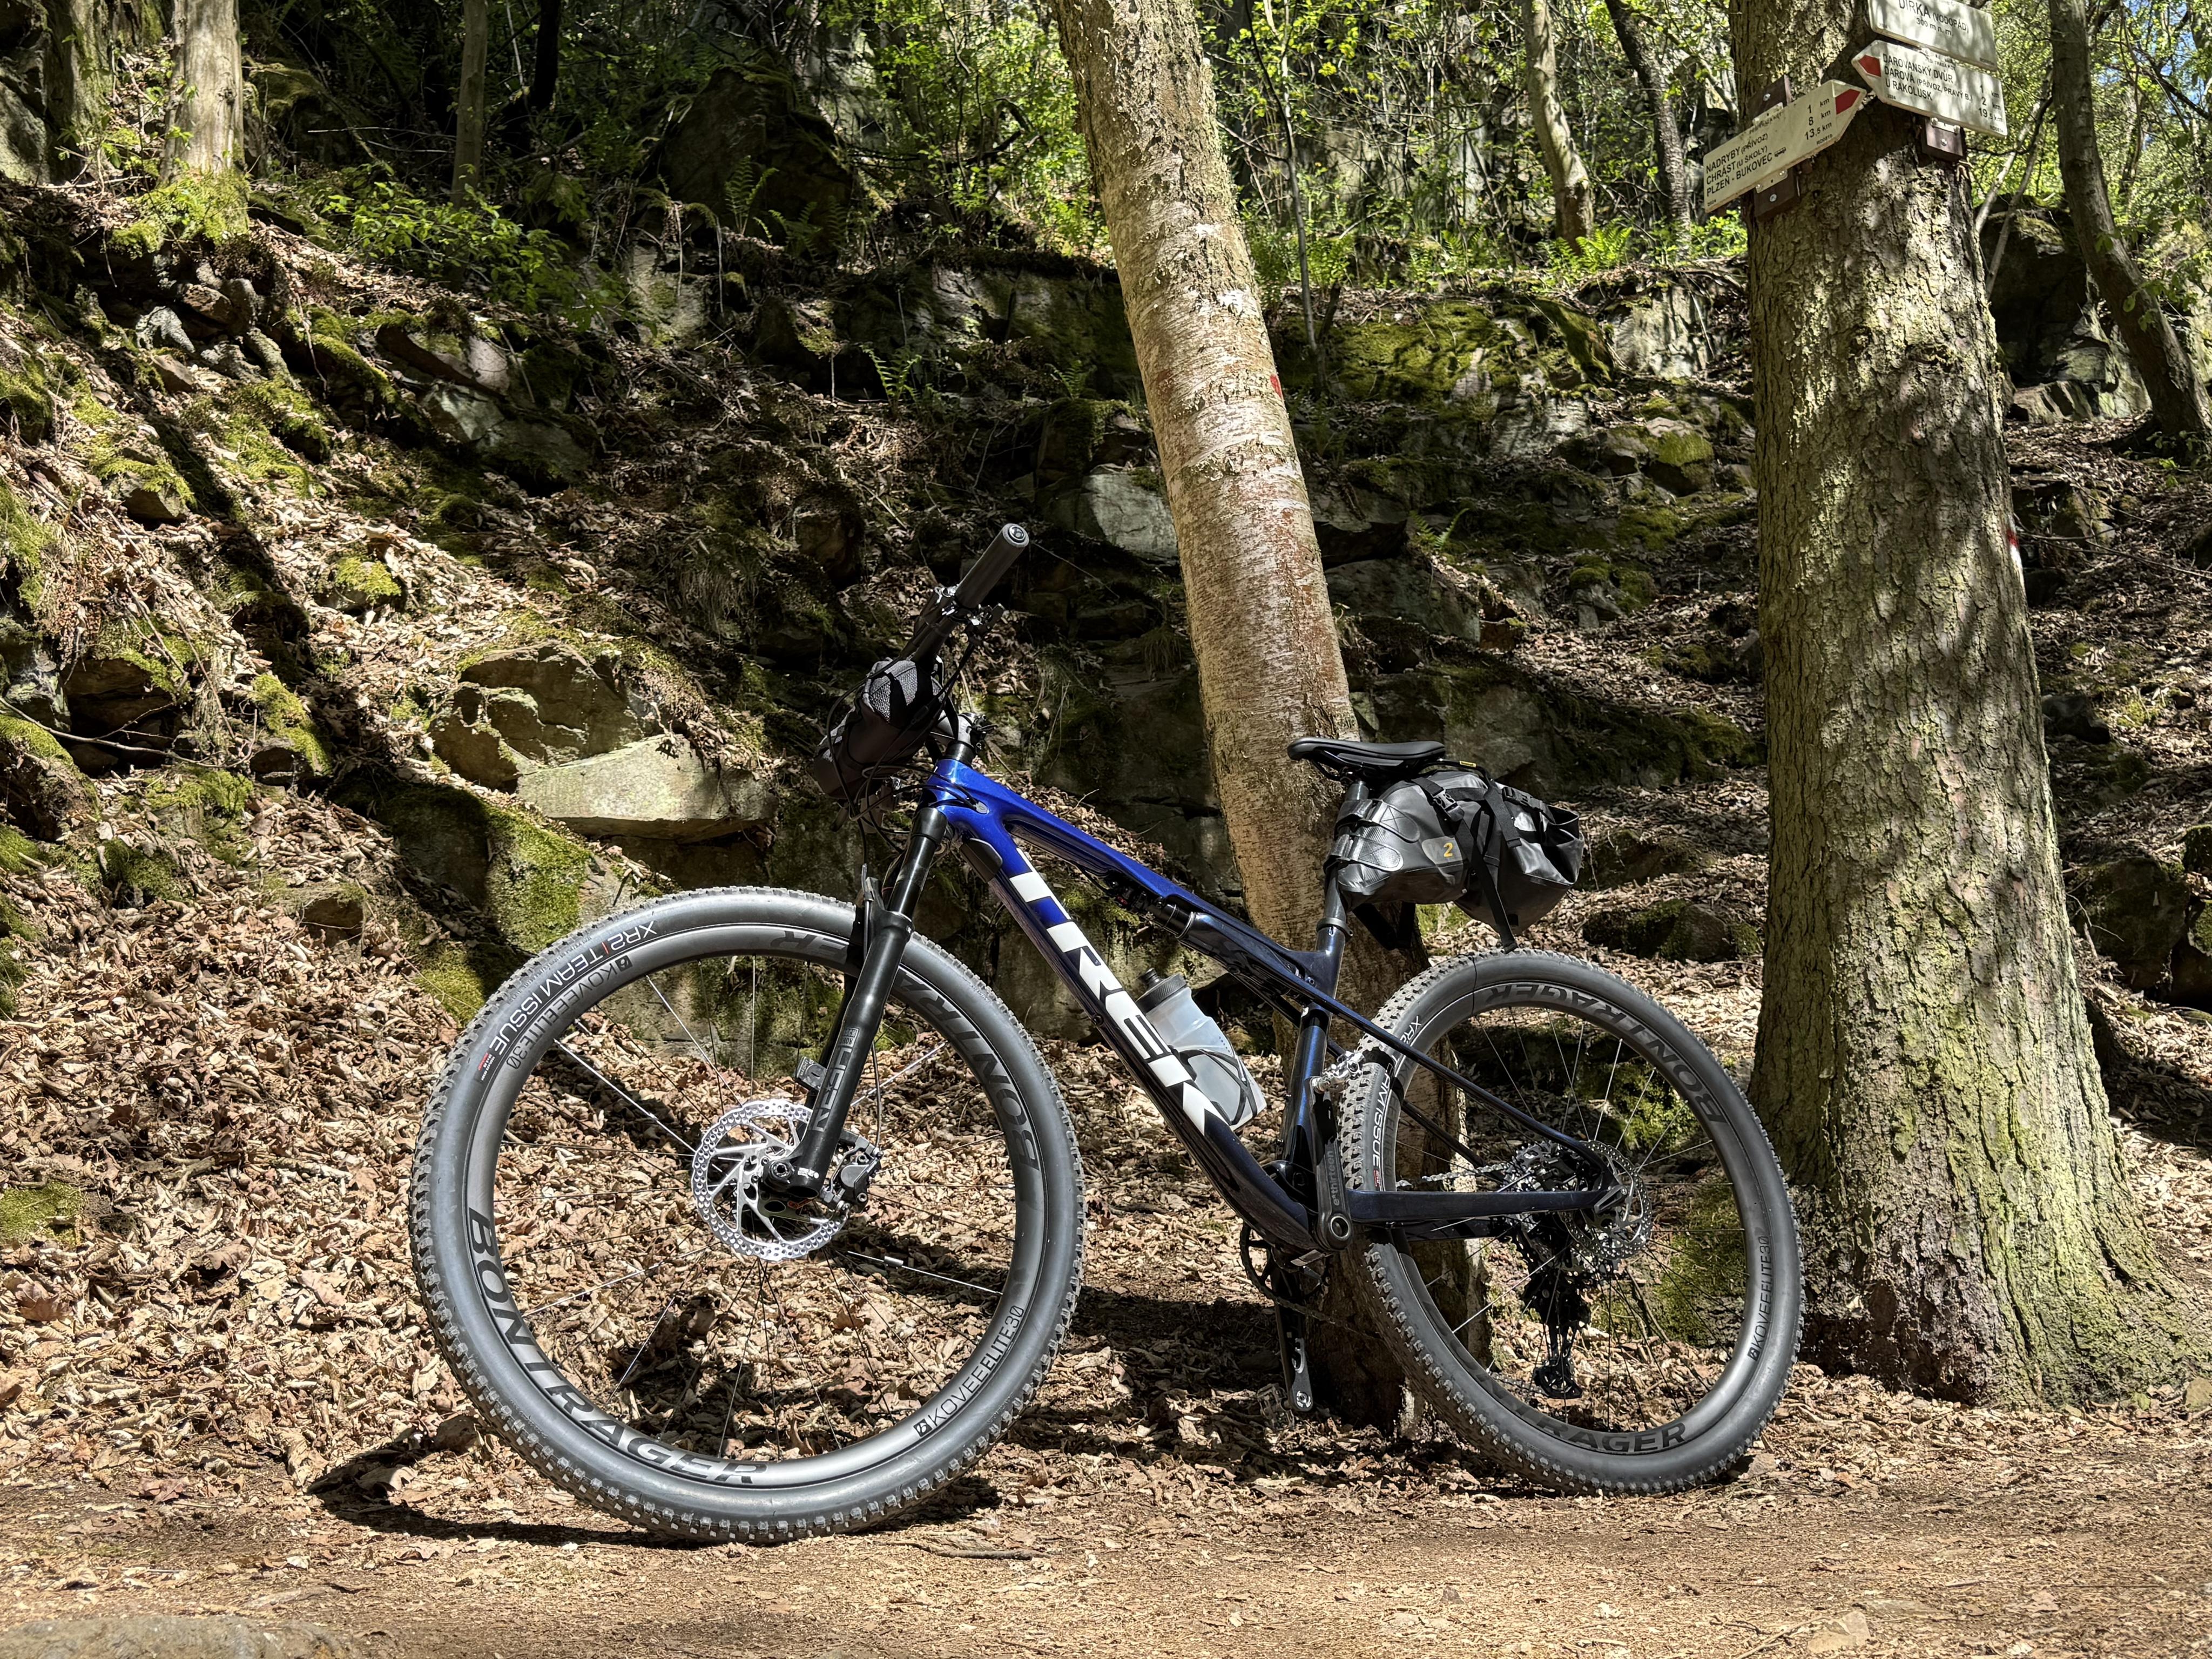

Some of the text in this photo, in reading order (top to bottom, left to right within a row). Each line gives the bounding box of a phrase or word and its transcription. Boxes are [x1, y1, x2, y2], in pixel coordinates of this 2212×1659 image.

[1917, 17, 1928, 27] 300
[1883, 53, 1932, 76] DAROVANSKÝ
[1980, 85, 1984, 93] 1
[1885, 78, 1891, 87] U
[1892, 80, 1932, 100] RAKOLUSK
[1981, 97, 1987, 105] 2
[1706, 146, 1740, 173] NADRYBY
[1808, 104, 1811, 113] 1
[1820, 98, 1830, 107] km
[1707, 161, 1736, 185] CHRÁST
[1744, 146, 1768, 163] ŠKOLY)
[1809, 117, 1813, 126] 8
[1821, 110, 1831, 119] km
[1707, 175, 1730, 197] PLZEŇ
[1736, 153, 1772, 180] BUKOVEC
[1805, 127, 1821, 140] 13,5
[1822, 122, 1832, 131] km
[608, 921, 657, 951] XR2
[539, 948, 604, 997] TEAM
[1009, 847, 1232, 1136] TREK
[489, 992, 542, 1055] ISSUE
[771, 930, 1040, 1172] BONTRAER
[1486, 983, 1726, 1124] BONTRAGER
[1372, 1107, 1384, 1167] ISSUE
[469, 1208, 768, 1485] BONTRAGER
